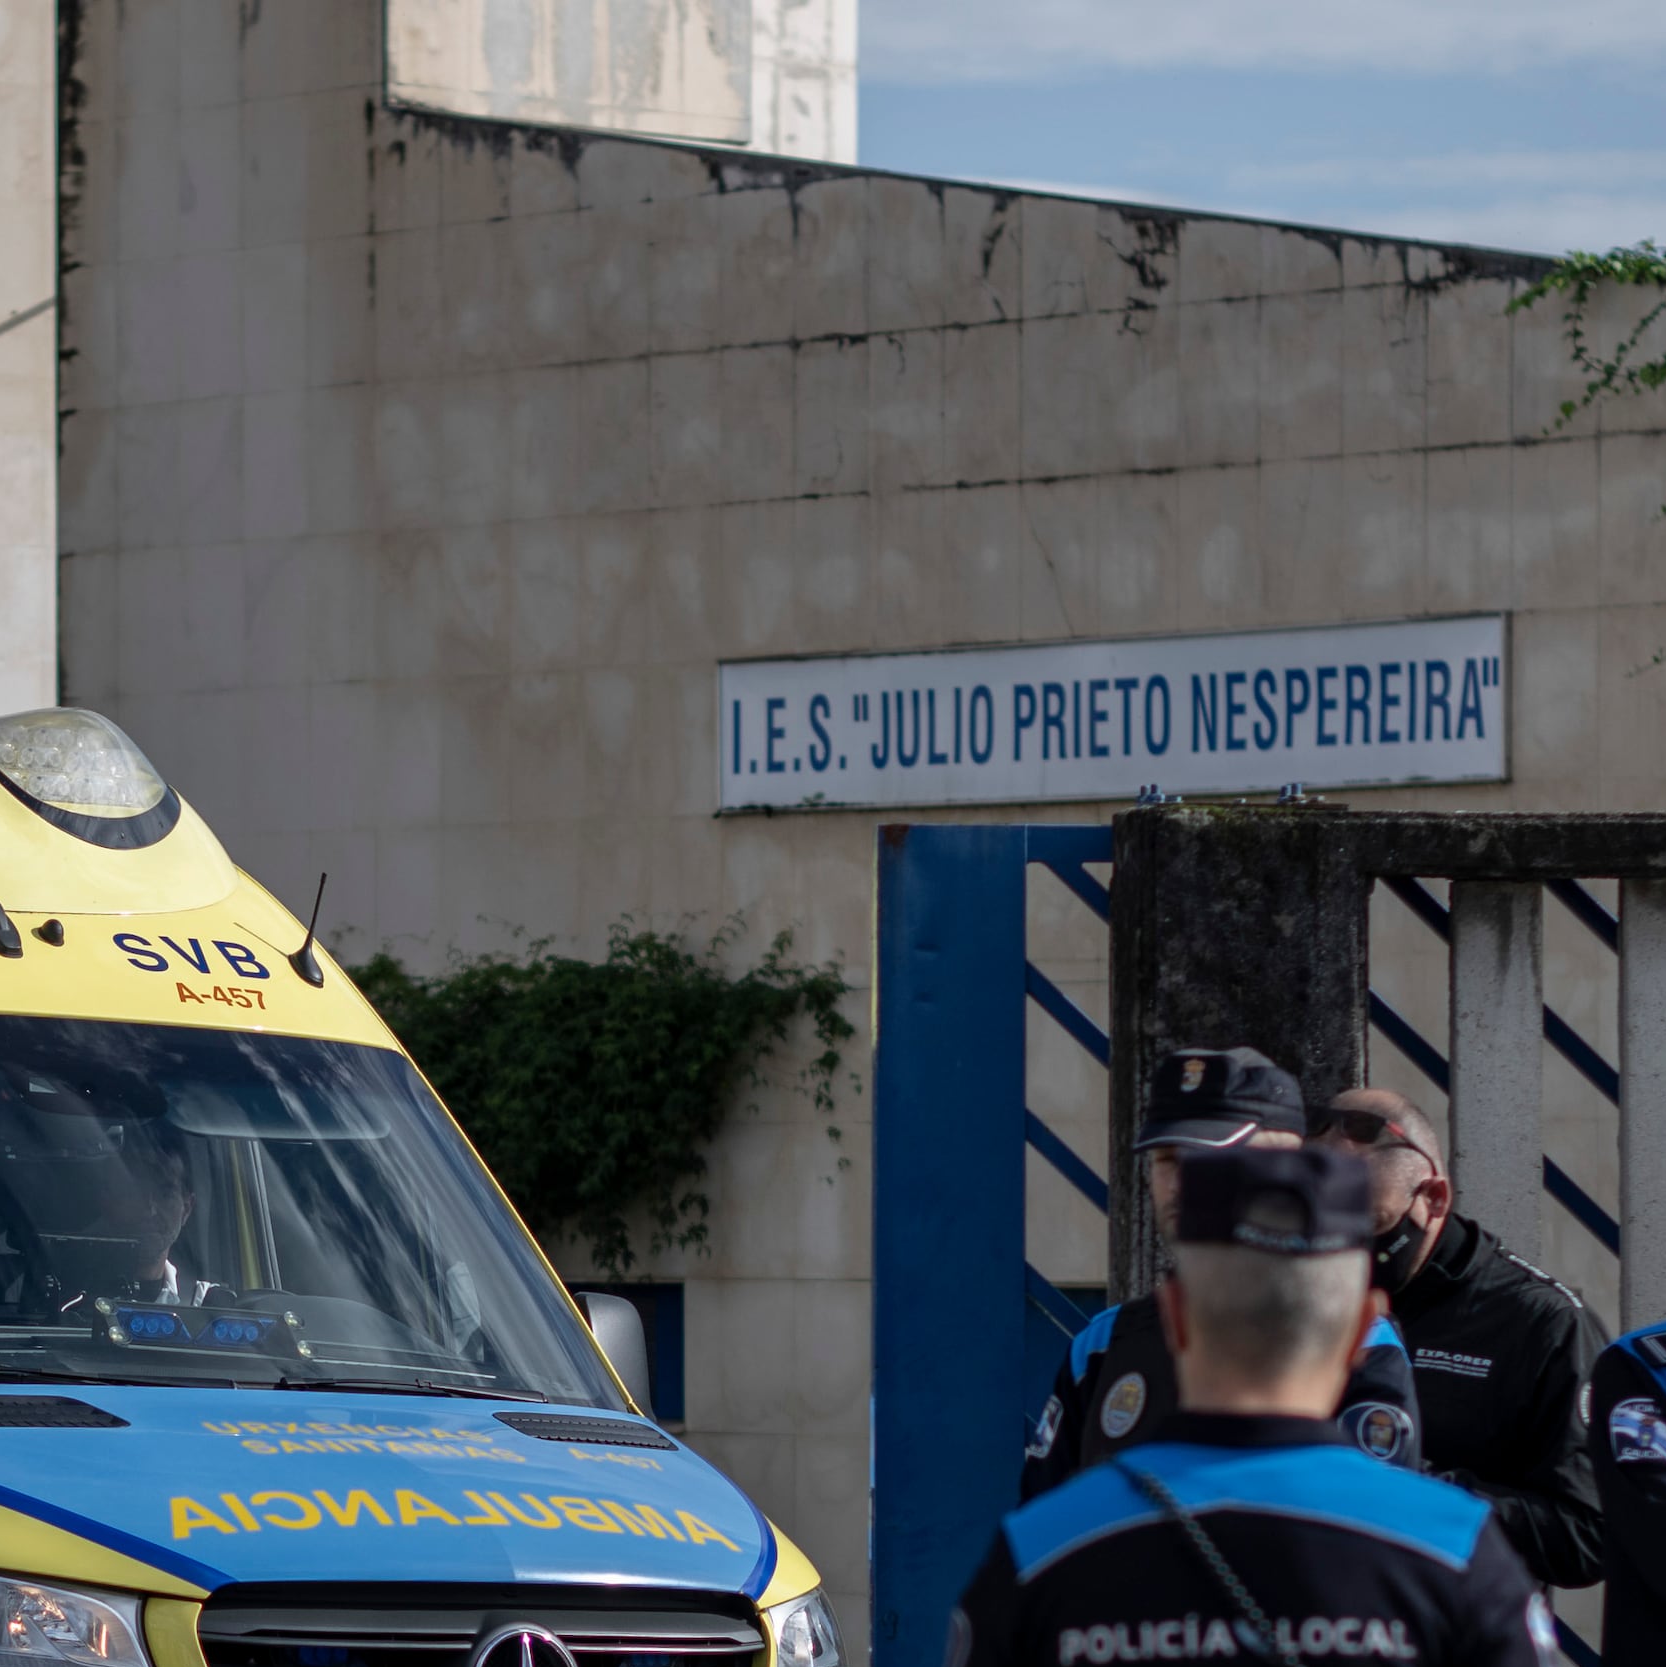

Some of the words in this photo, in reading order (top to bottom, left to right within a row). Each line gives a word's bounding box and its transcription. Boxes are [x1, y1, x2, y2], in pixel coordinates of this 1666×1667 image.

[1012, 673, 1172, 762] PRIETO
[1190, 655, 1501, 755] NESPEREIRA"
[112, 931, 271, 982] SVB
[174, 981, 266, 1011] A-457
[1414, 1347, 1492, 1367] EXPLORER
[200, 1420, 494, 1444] URXENCIAS
[240, 1438, 527, 1463] SANITARIAS
[1275, 1615, 1418, 1659] LOCAL
